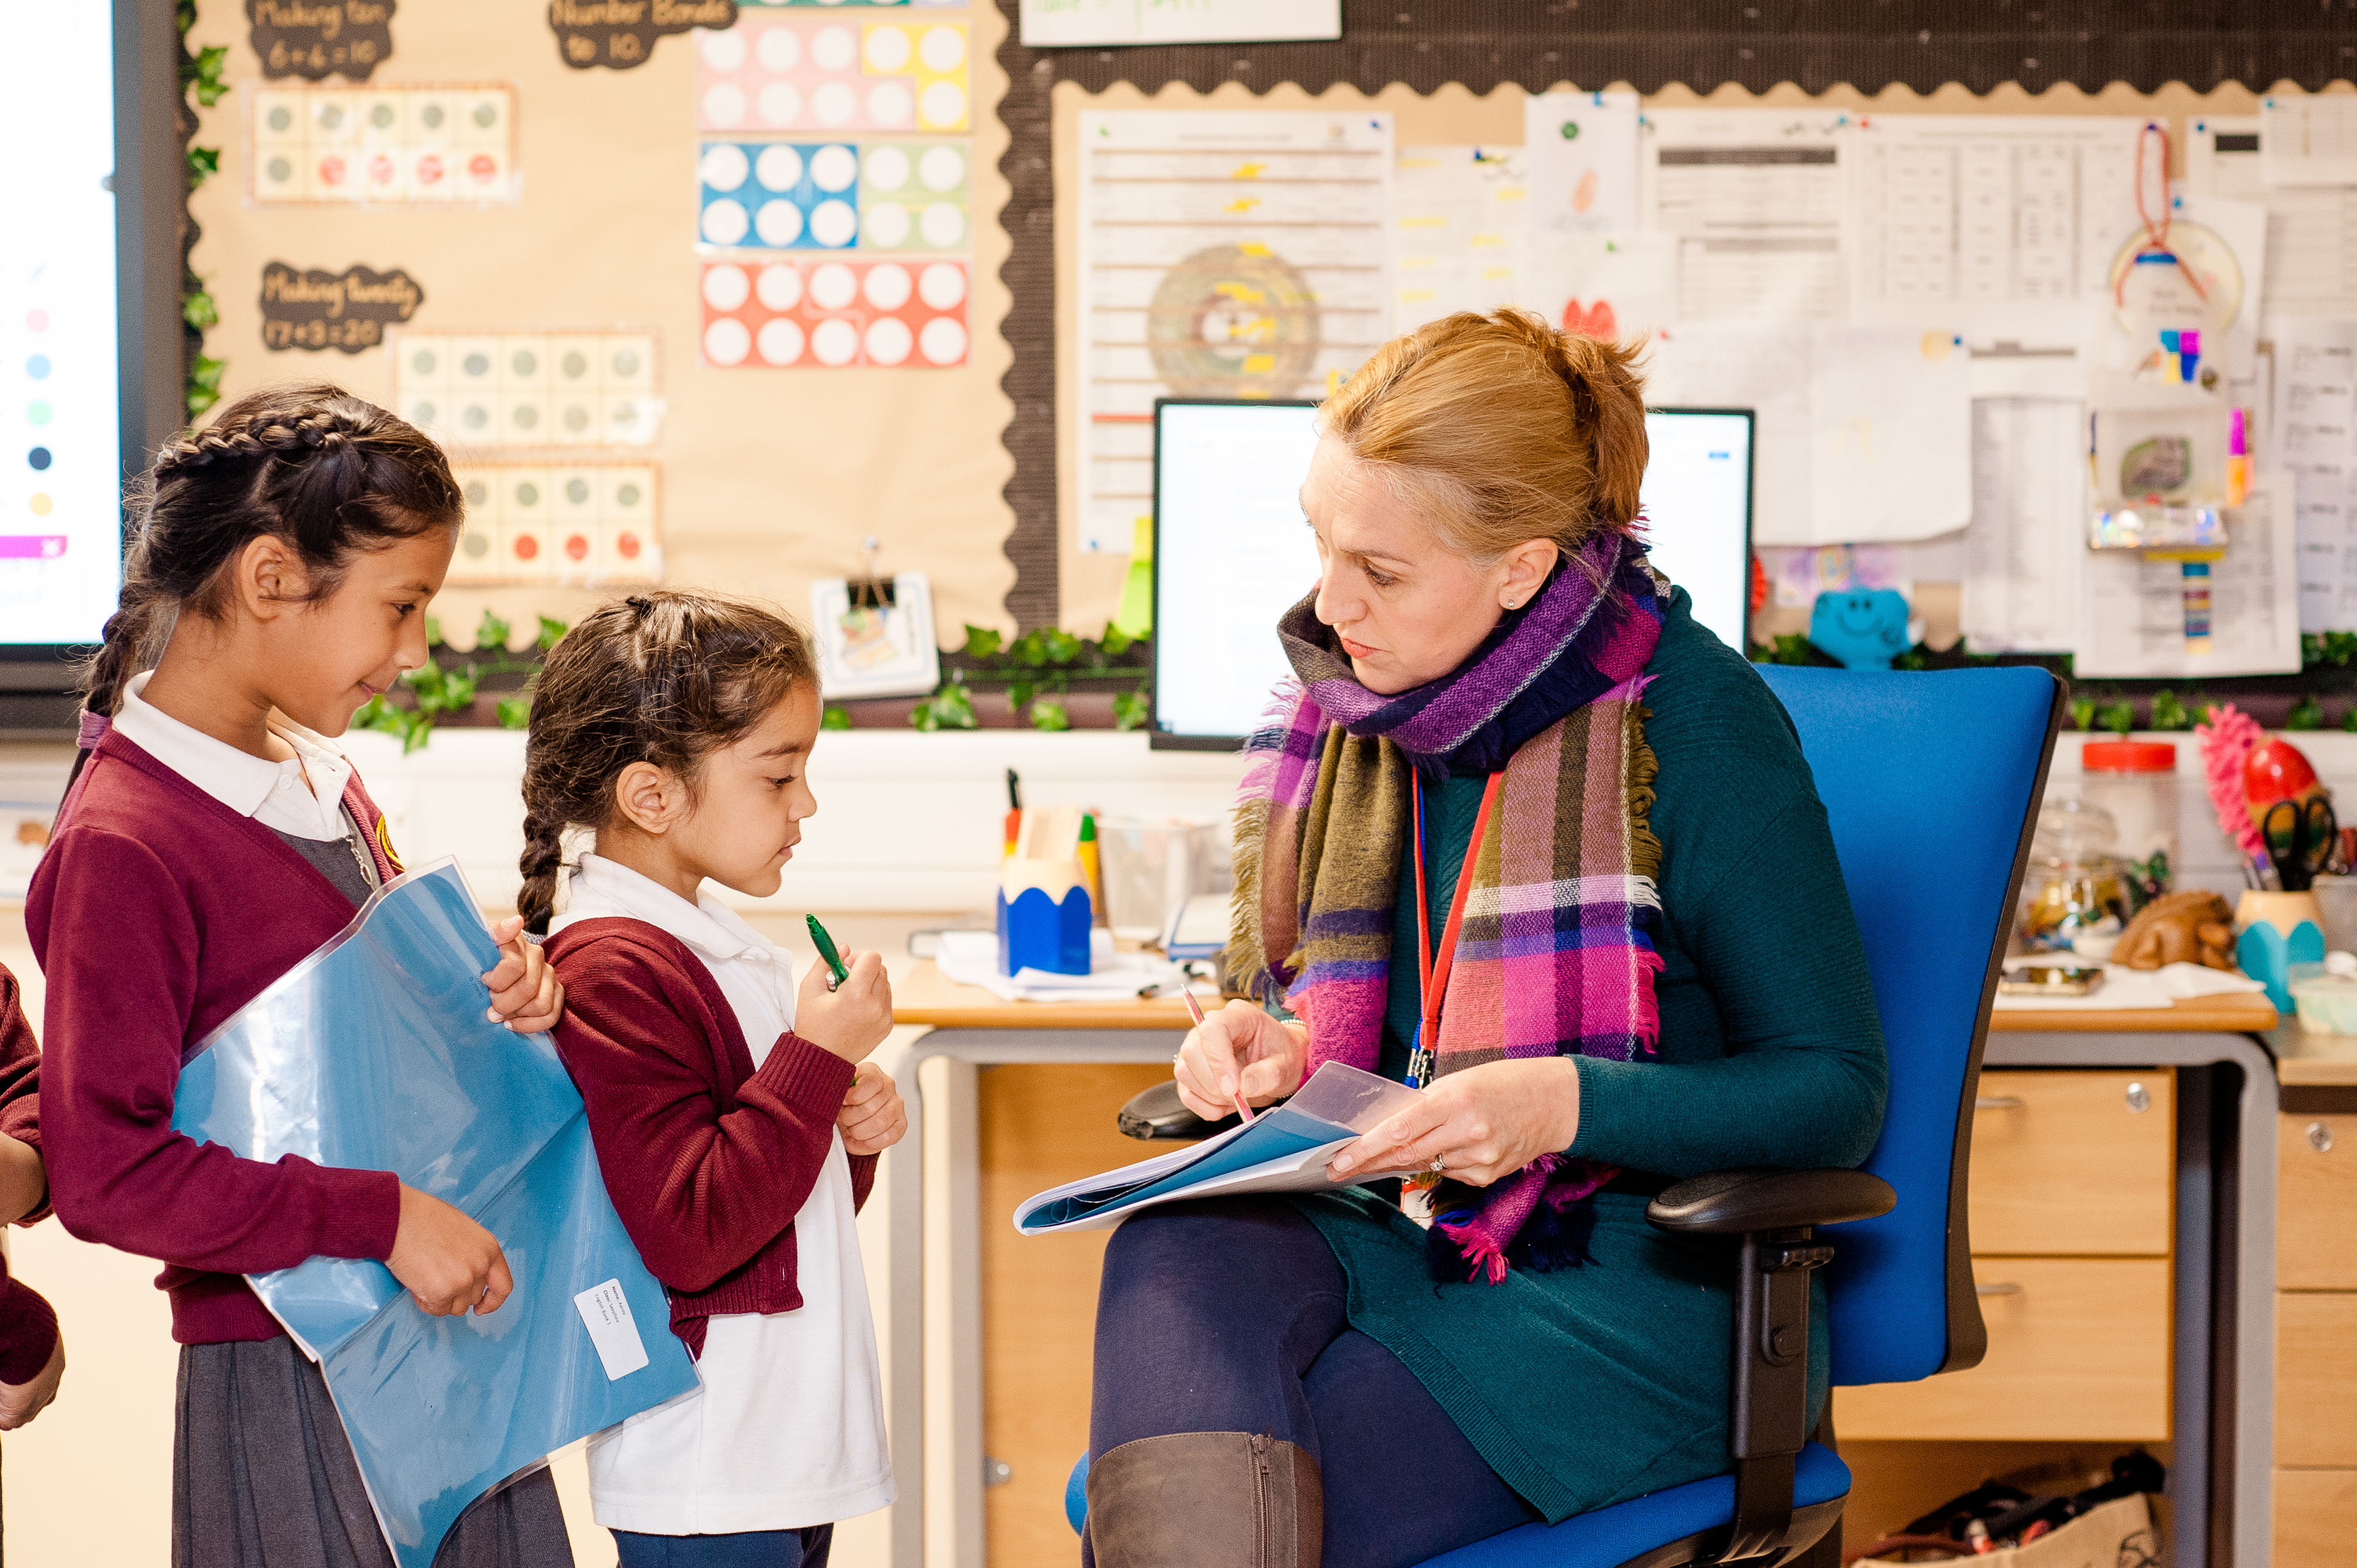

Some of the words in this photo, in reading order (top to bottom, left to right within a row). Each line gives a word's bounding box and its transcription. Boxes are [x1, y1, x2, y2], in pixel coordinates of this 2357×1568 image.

[255, 0, 343, 41] Making
[265, 270, 344, 319] Making
[346, 274, 417, 318] twenty
[594, 1293, 604, 1310] English
[612, 1286, 620, 1302] Name:
[609, 1303, 619, 1323] Sapphire
